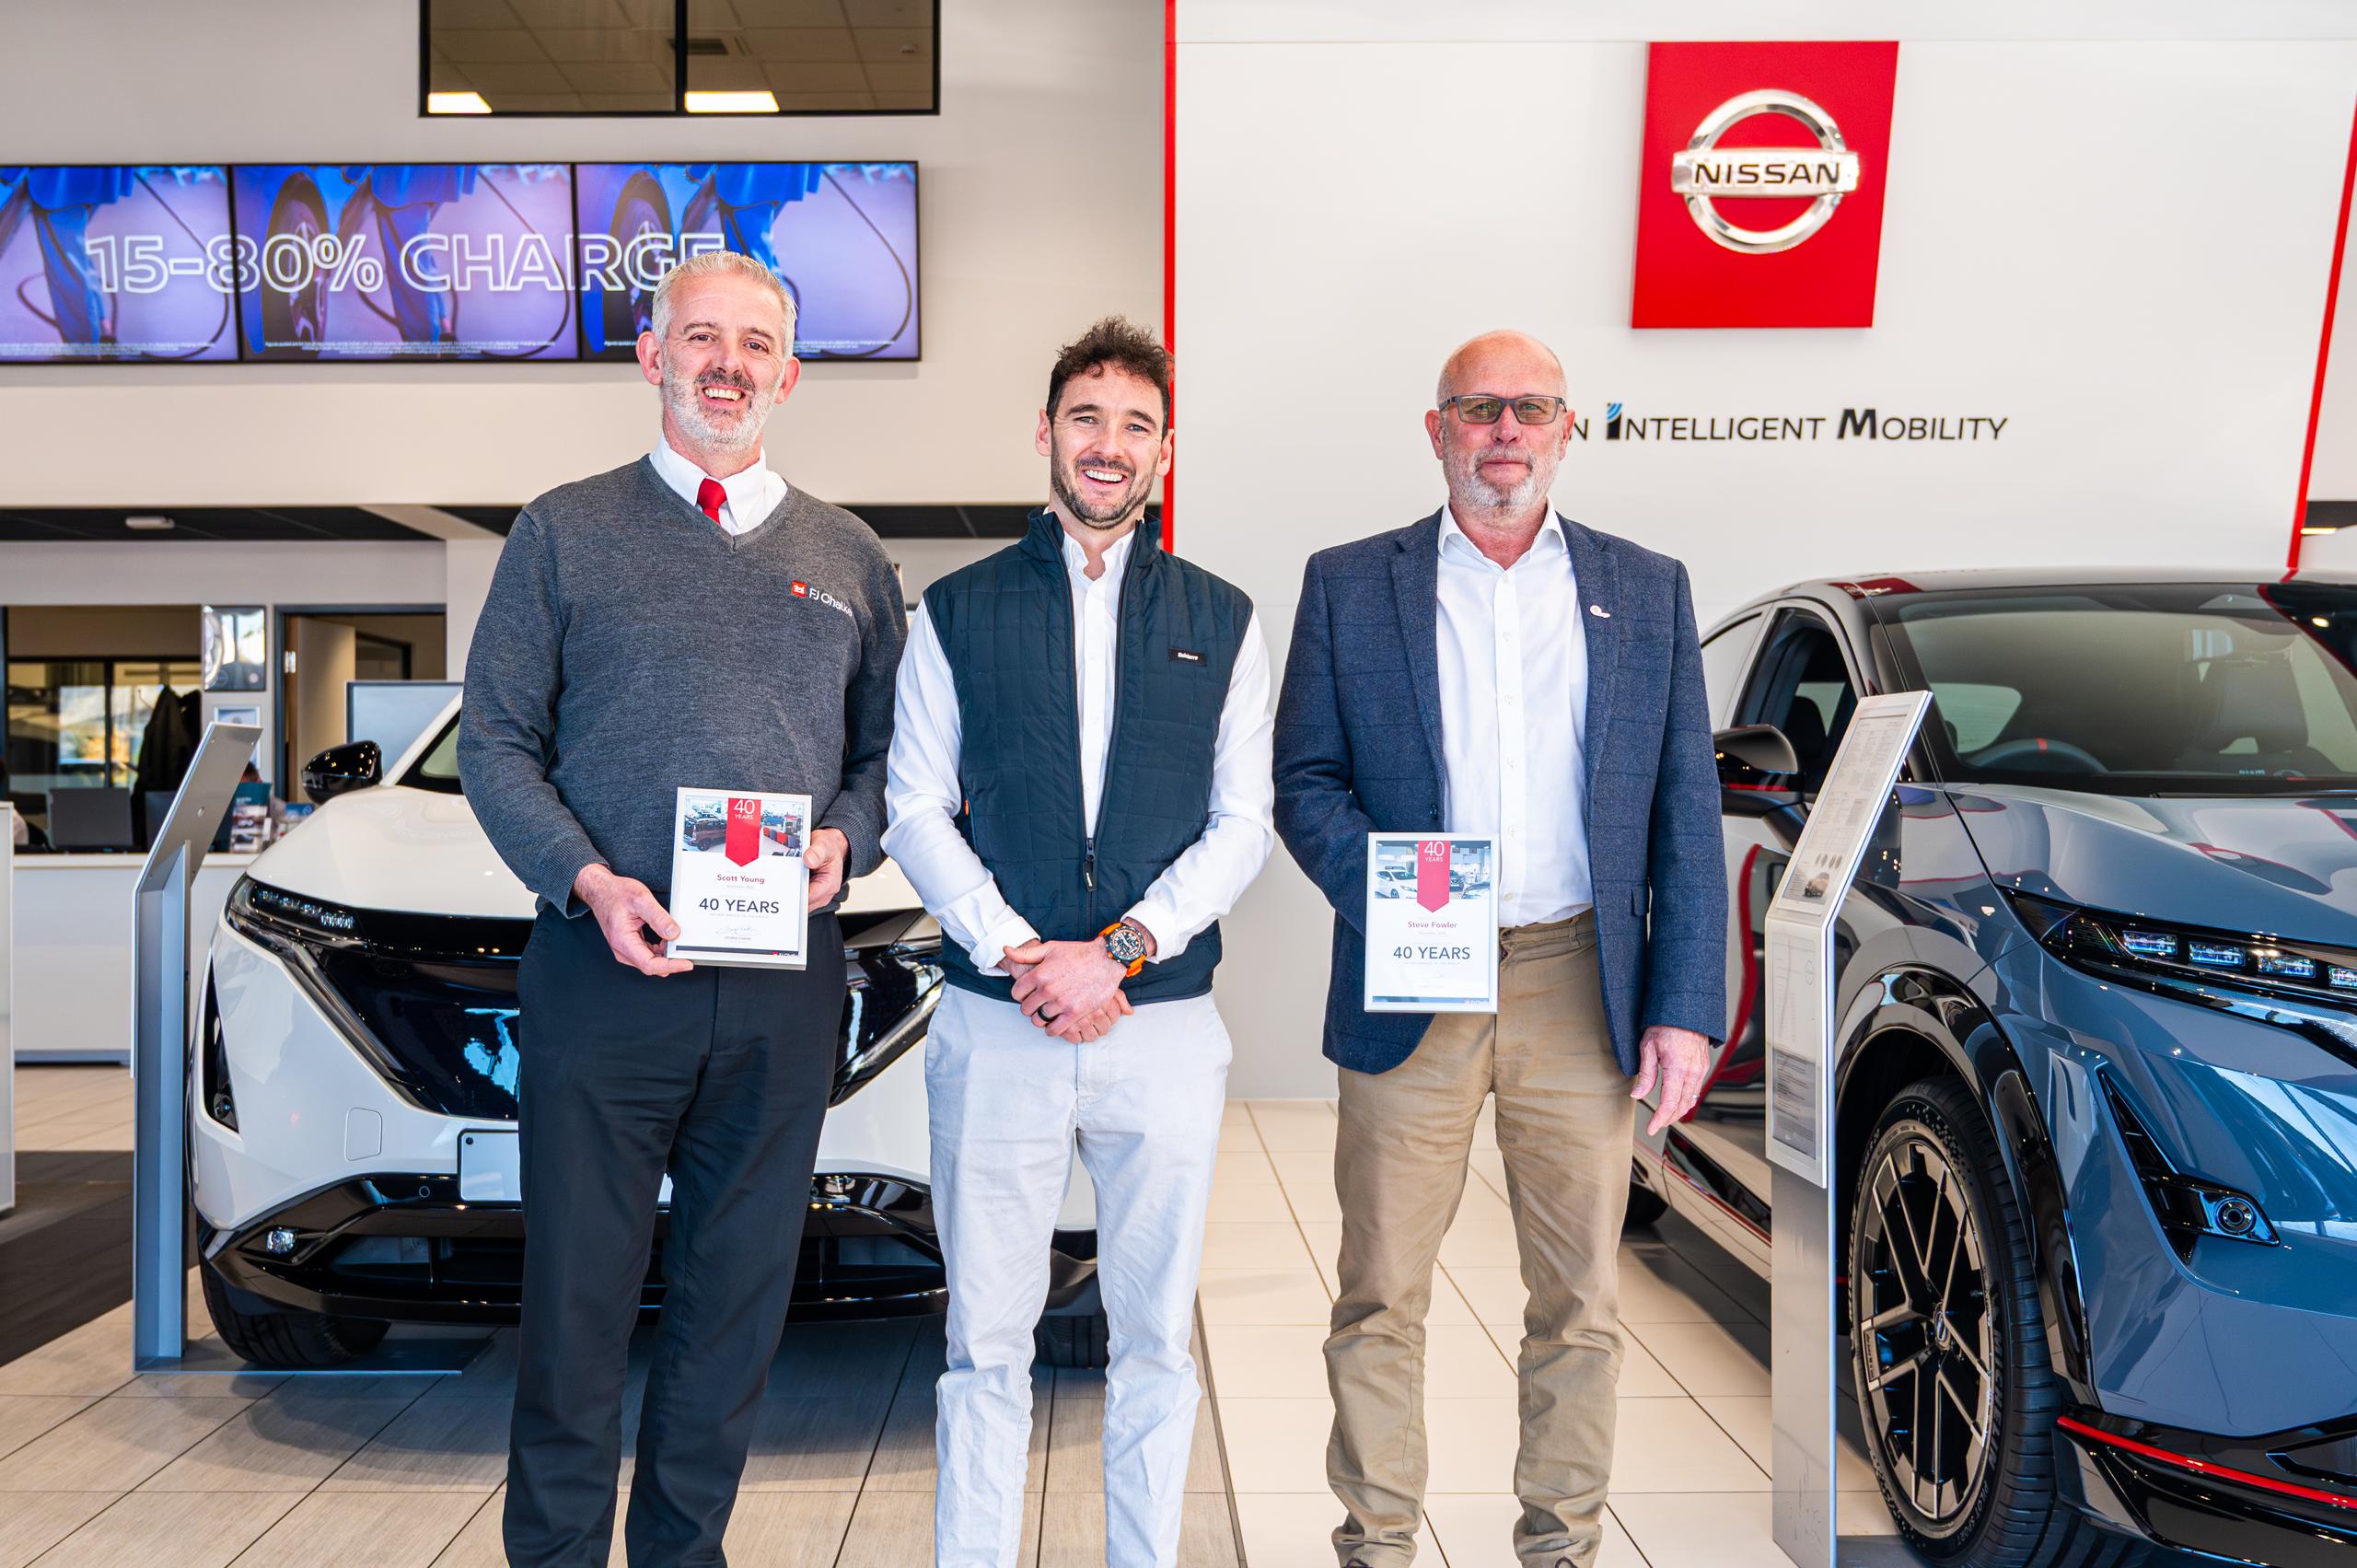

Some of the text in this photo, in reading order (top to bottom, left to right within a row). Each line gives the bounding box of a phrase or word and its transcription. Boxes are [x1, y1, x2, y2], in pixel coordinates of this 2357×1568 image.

[1694, 163, 1840, 184] NISSAN
[1605, 402, 1827, 441] INTELLIGENT
[1837, 408, 2009, 441] MOBILITY
[808, 587, 819, 600] FJ
[734, 799, 755, 814] 40
[1423, 841, 1445, 857] 40
[716, 874, 765, 885] Scott Young
[699, 898, 779, 913] 40 YEARS
[1407, 921, 1458, 929] Steve Fowler
[1393, 946, 1470, 959] 40 YEARS
[1990, 1328, 2003, 1471] MICHELIN
